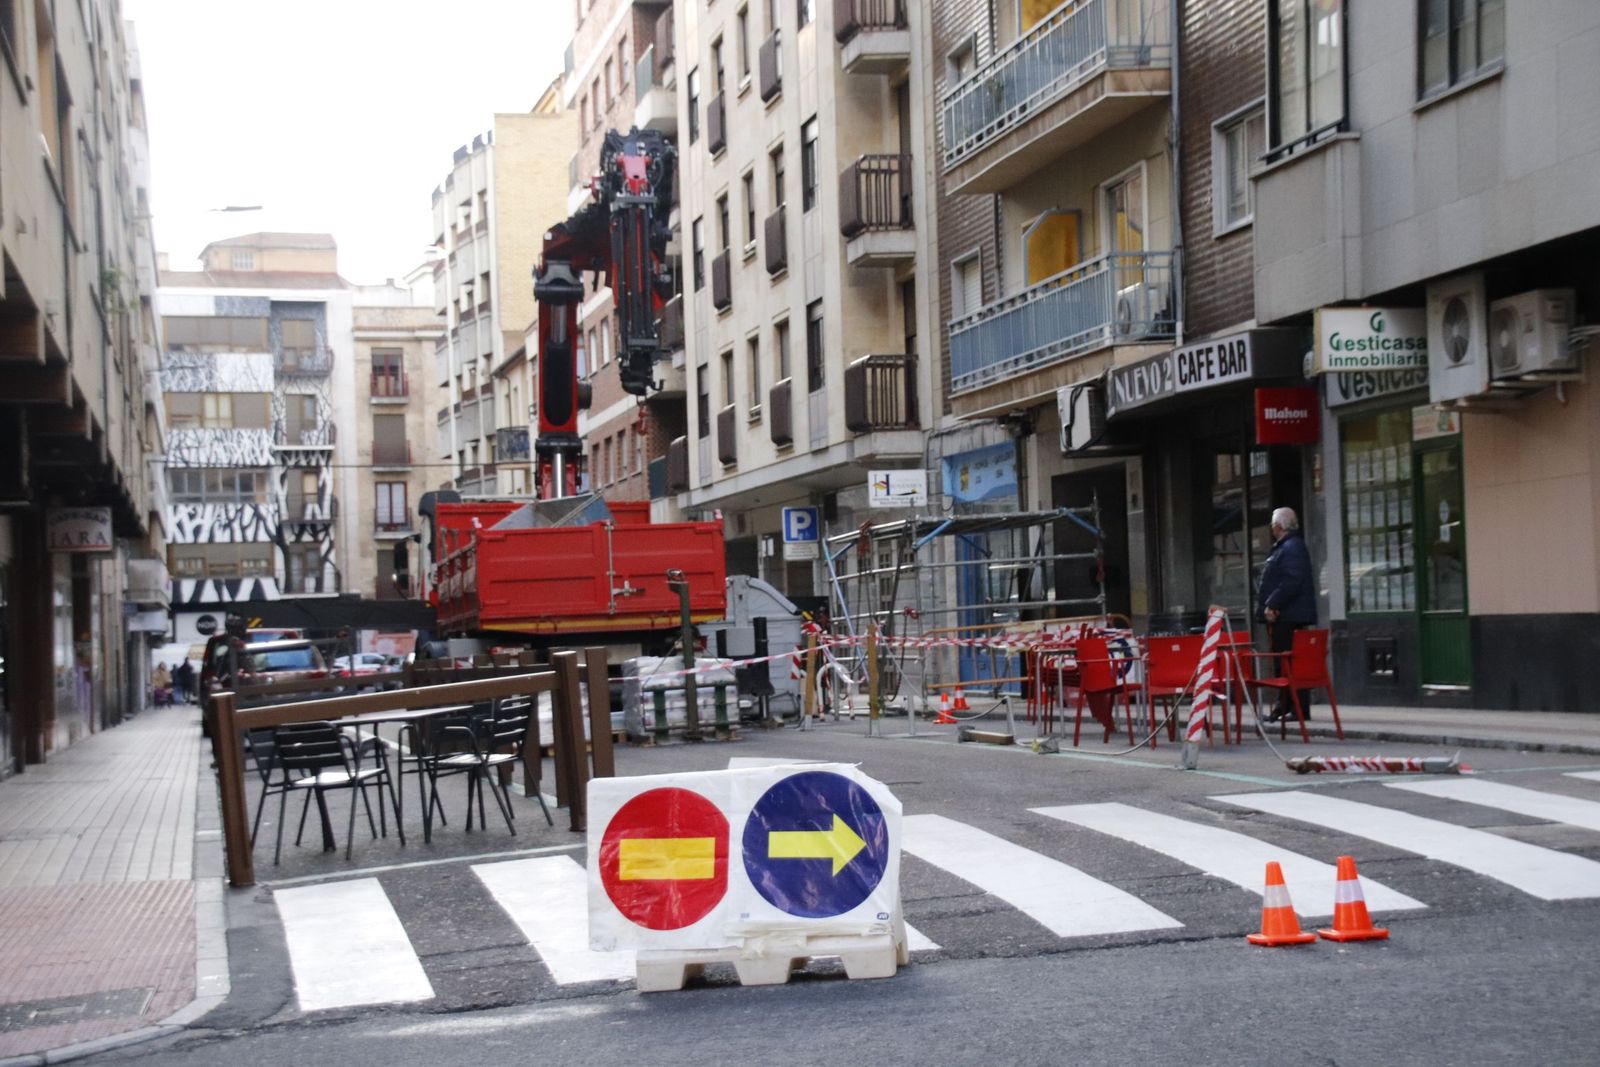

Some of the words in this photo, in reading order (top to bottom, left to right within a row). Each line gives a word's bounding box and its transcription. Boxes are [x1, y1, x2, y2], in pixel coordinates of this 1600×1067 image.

[1329, 332, 1427, 351] Gesticasa
[1178, 345, 1215, 386] CAFE
[1218, 339, 1247, 377] BAR
[1328, 352, 1429, 367] inmobiliaria
[1114, 361, 1161, 403] NUEVO
[1163, 357, 1173, 391] 2
[1264, 407, 1308, 419] Mahou
[790, 510, 812, 539] P
